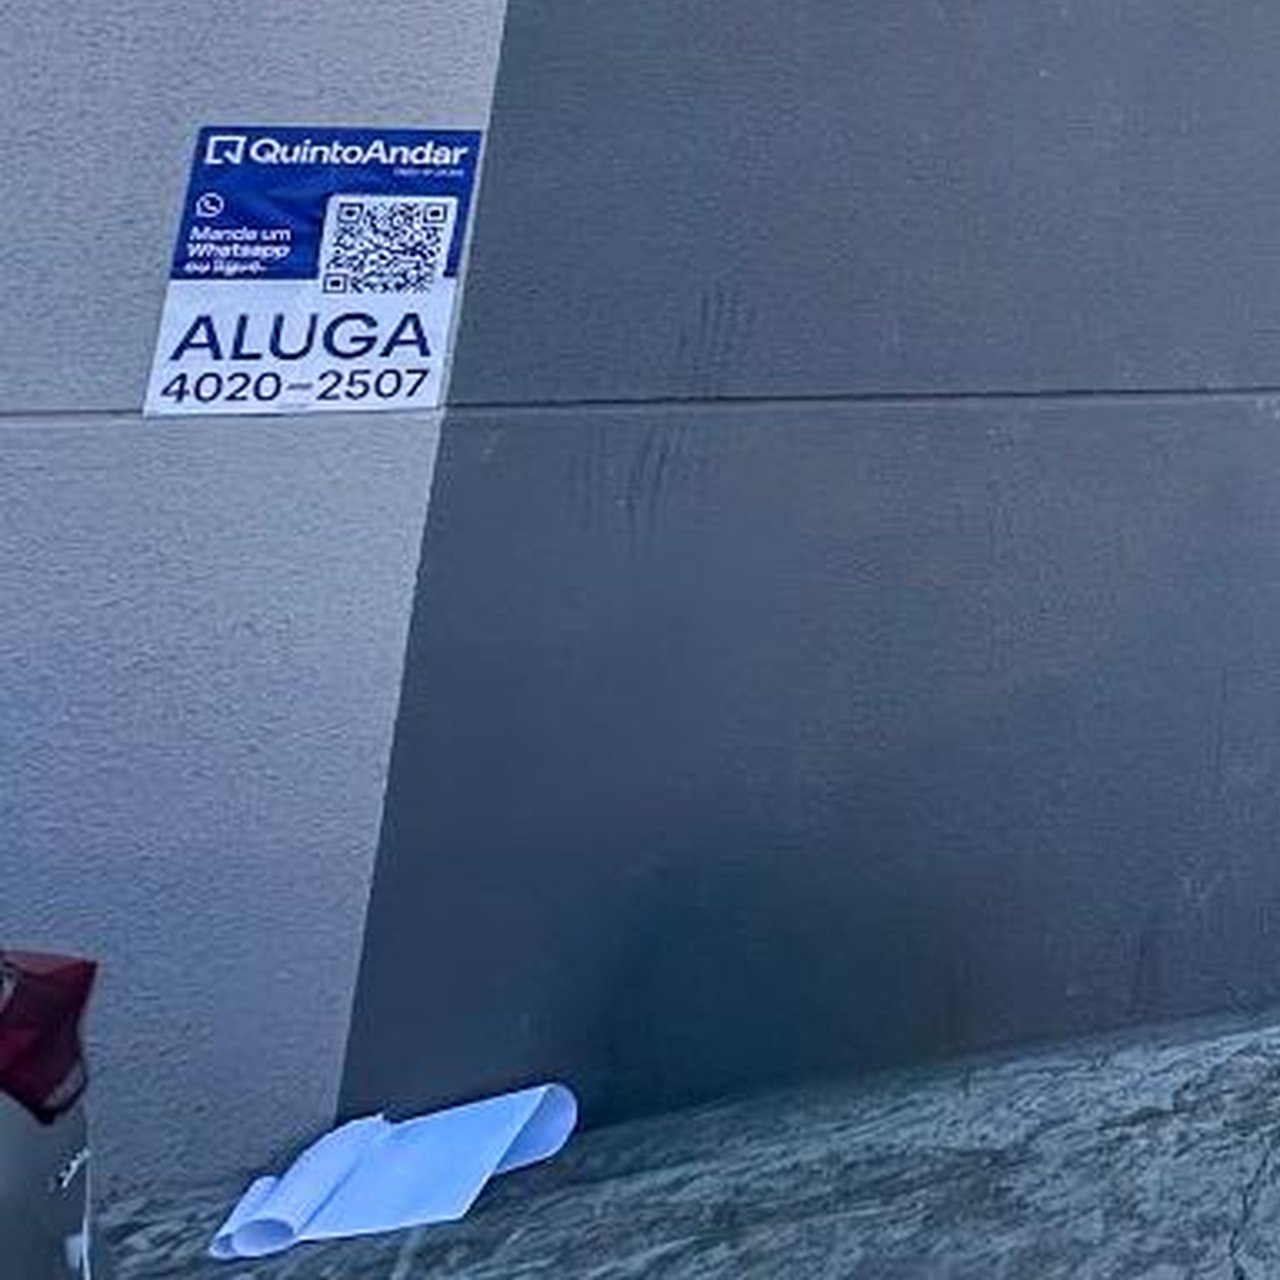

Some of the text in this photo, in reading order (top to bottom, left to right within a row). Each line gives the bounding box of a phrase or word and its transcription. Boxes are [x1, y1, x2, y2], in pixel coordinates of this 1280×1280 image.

[249, 139, 468, 166] QuintoAndar
[261, 228, 291, 241] um
[186, 243, 291, 260] Whatsapp
[169, 312, 431, 361] ALUGA
[160, 368, 430, 404] 4020-2507
